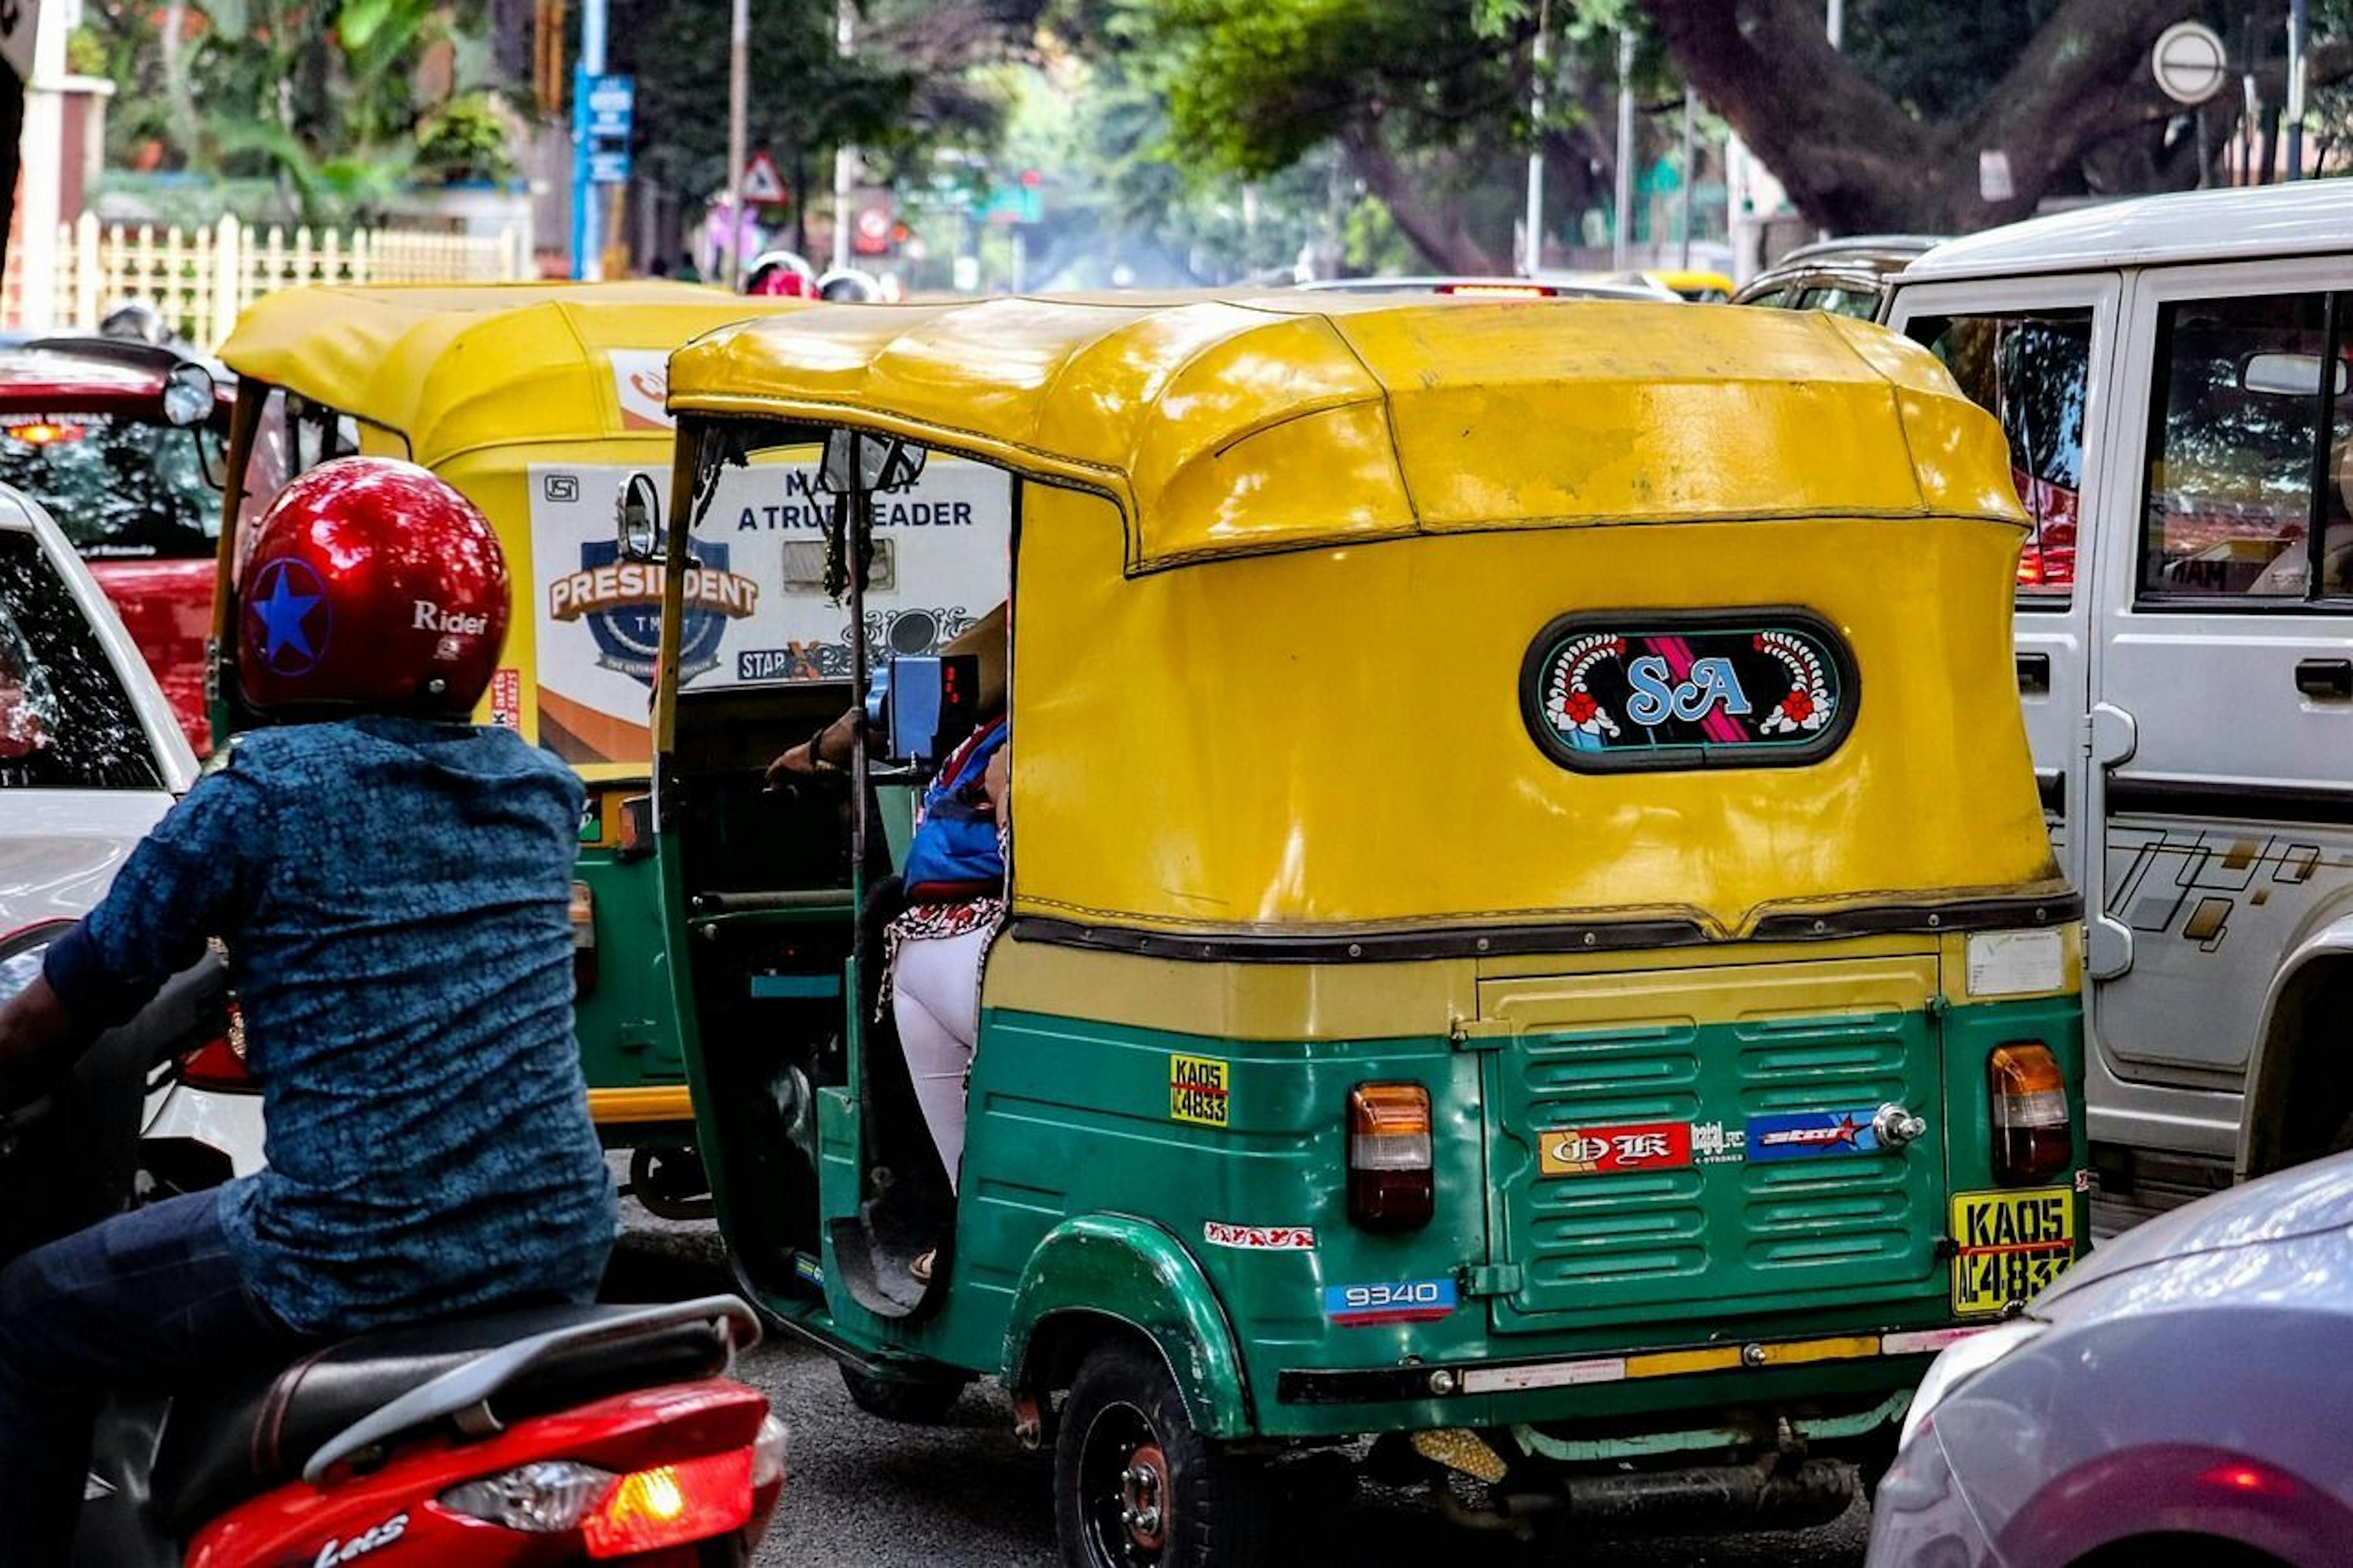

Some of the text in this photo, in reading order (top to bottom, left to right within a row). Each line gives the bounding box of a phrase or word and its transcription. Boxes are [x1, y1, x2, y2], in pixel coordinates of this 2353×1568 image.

[738, 507, 757, 531] A
[868, 502, 972, 528] EADER
[411, 599, 490, 636] Rider
[1176, 1061, 1221, 1088] KA05
[1182, 1089, 1224, 1121] 4833
[1691, 1121, 1723, 1156] bajaj
[1967, 1199, 2063, 1246] KA05
[1346, 1283, 1438, 1306] 9340
